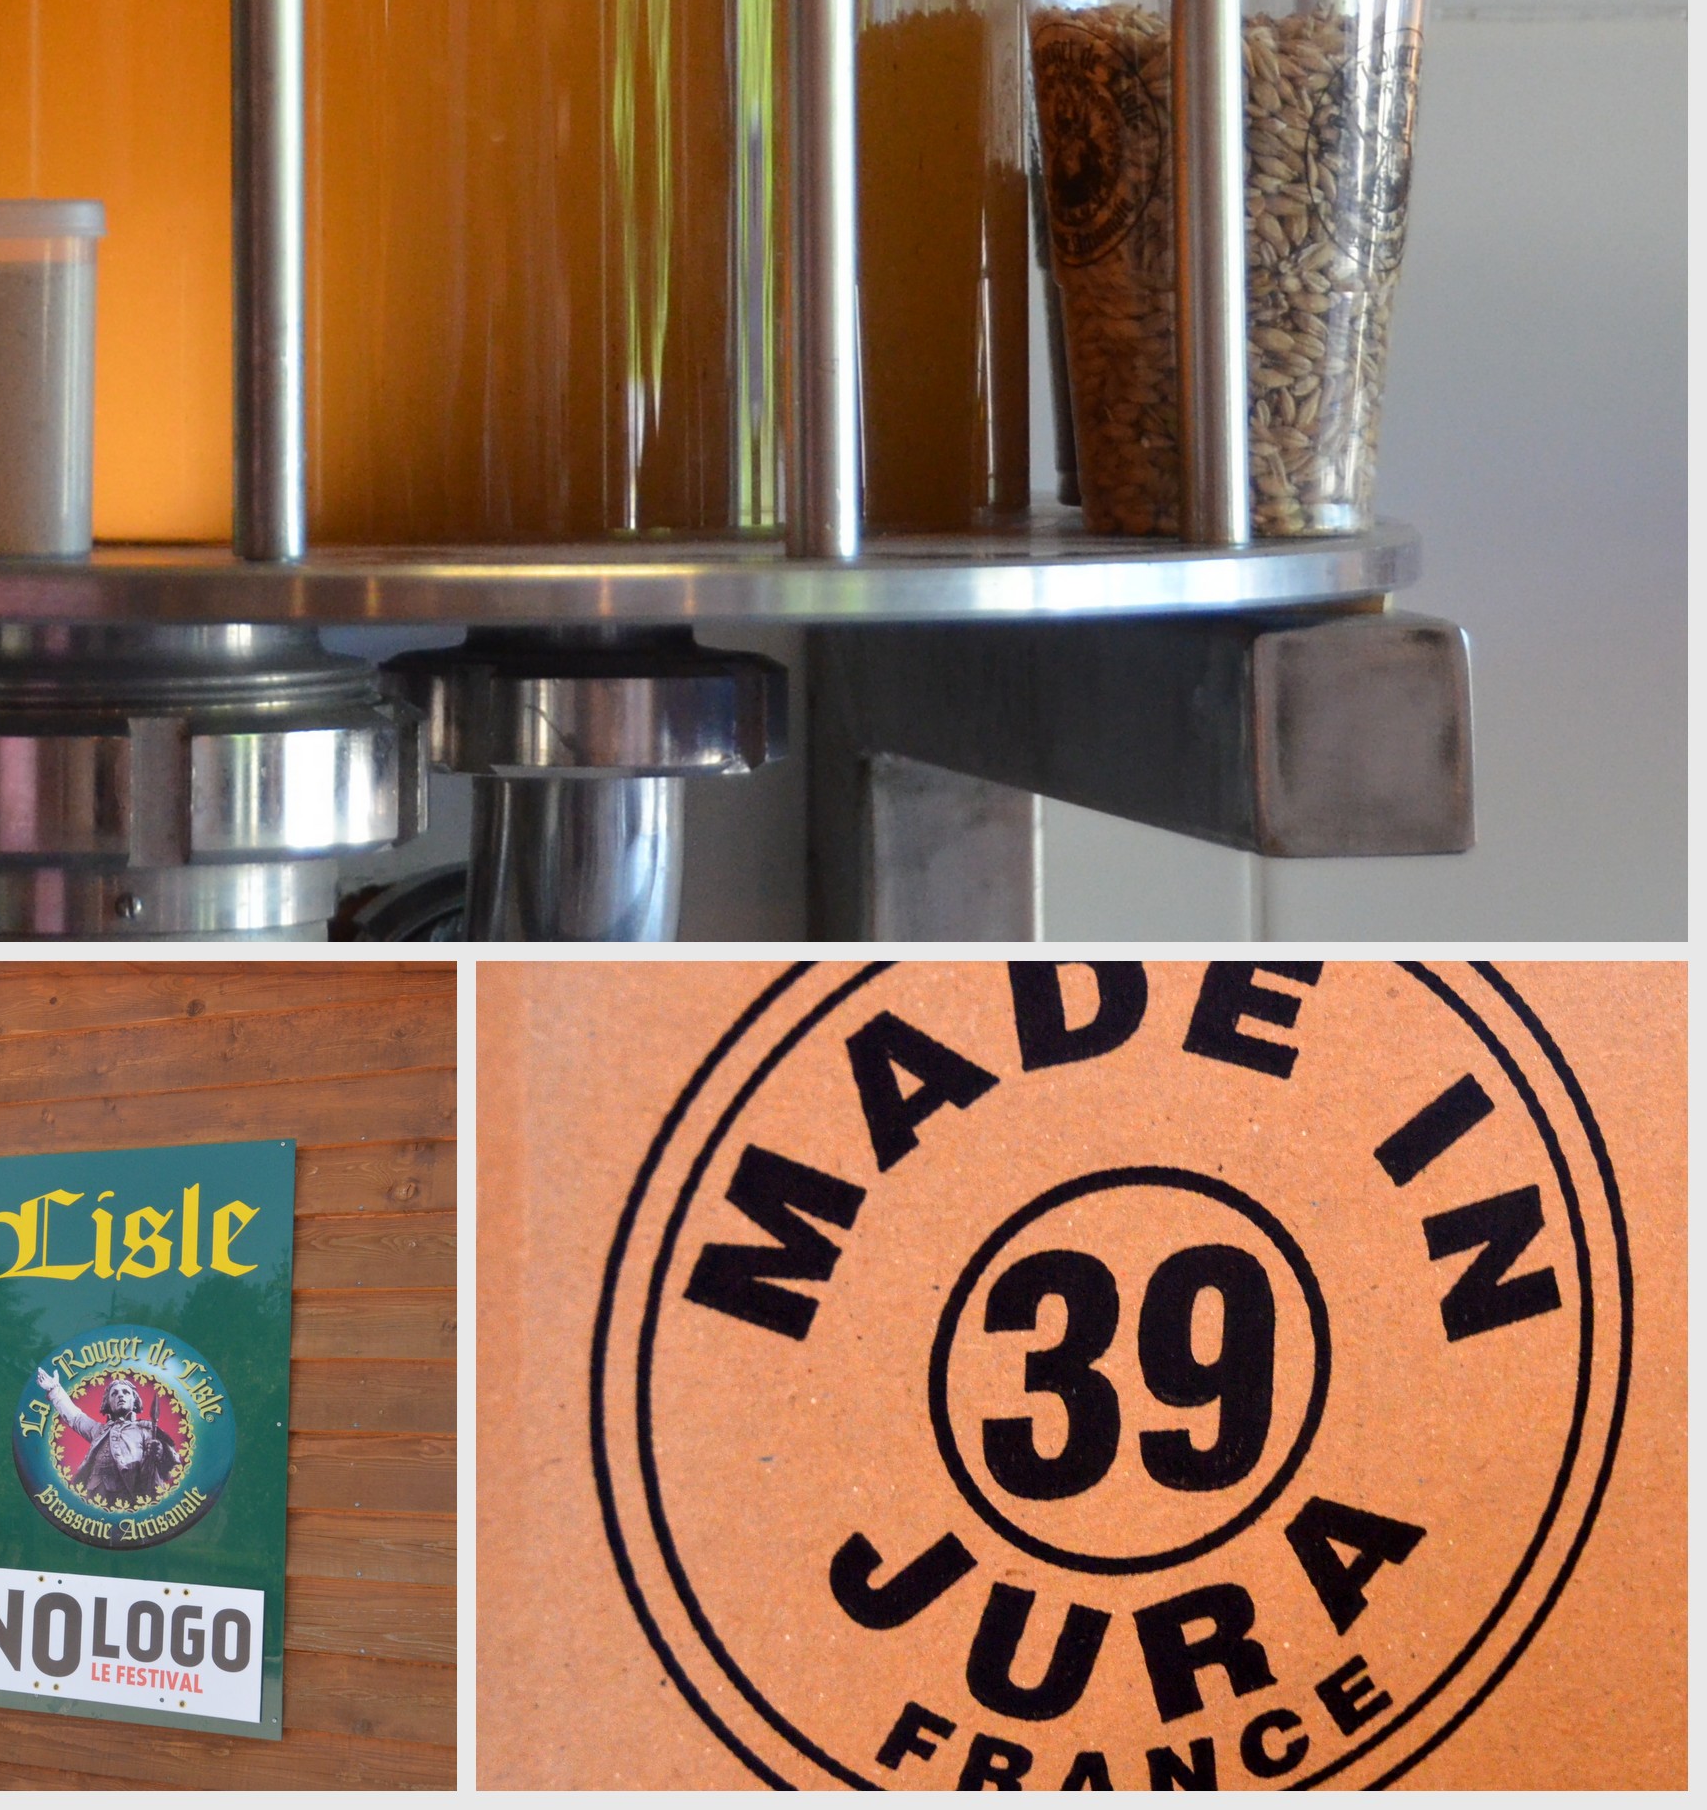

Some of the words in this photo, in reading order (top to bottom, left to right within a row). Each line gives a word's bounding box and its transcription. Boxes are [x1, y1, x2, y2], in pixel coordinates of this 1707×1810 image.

[681, 961, 1325, 1342] MADE
[1372, 1072, 1563, 1343] IN
[19, 1398, 51, 1438] La
[51, 1335, 143, 1381] Rouget
[147, 1337, 177, 1370] de
[982, 1243, 1277, 1502] 39
[33, 1483, 113, 1541] Brasserie
[118, 1485, 209, 1542] Artisanale
[91, 1662, 111, 1683] LE
[116, 1664, 204, 1694] FESTIVAL
[828, 1496, 1427, 1723] JURA
